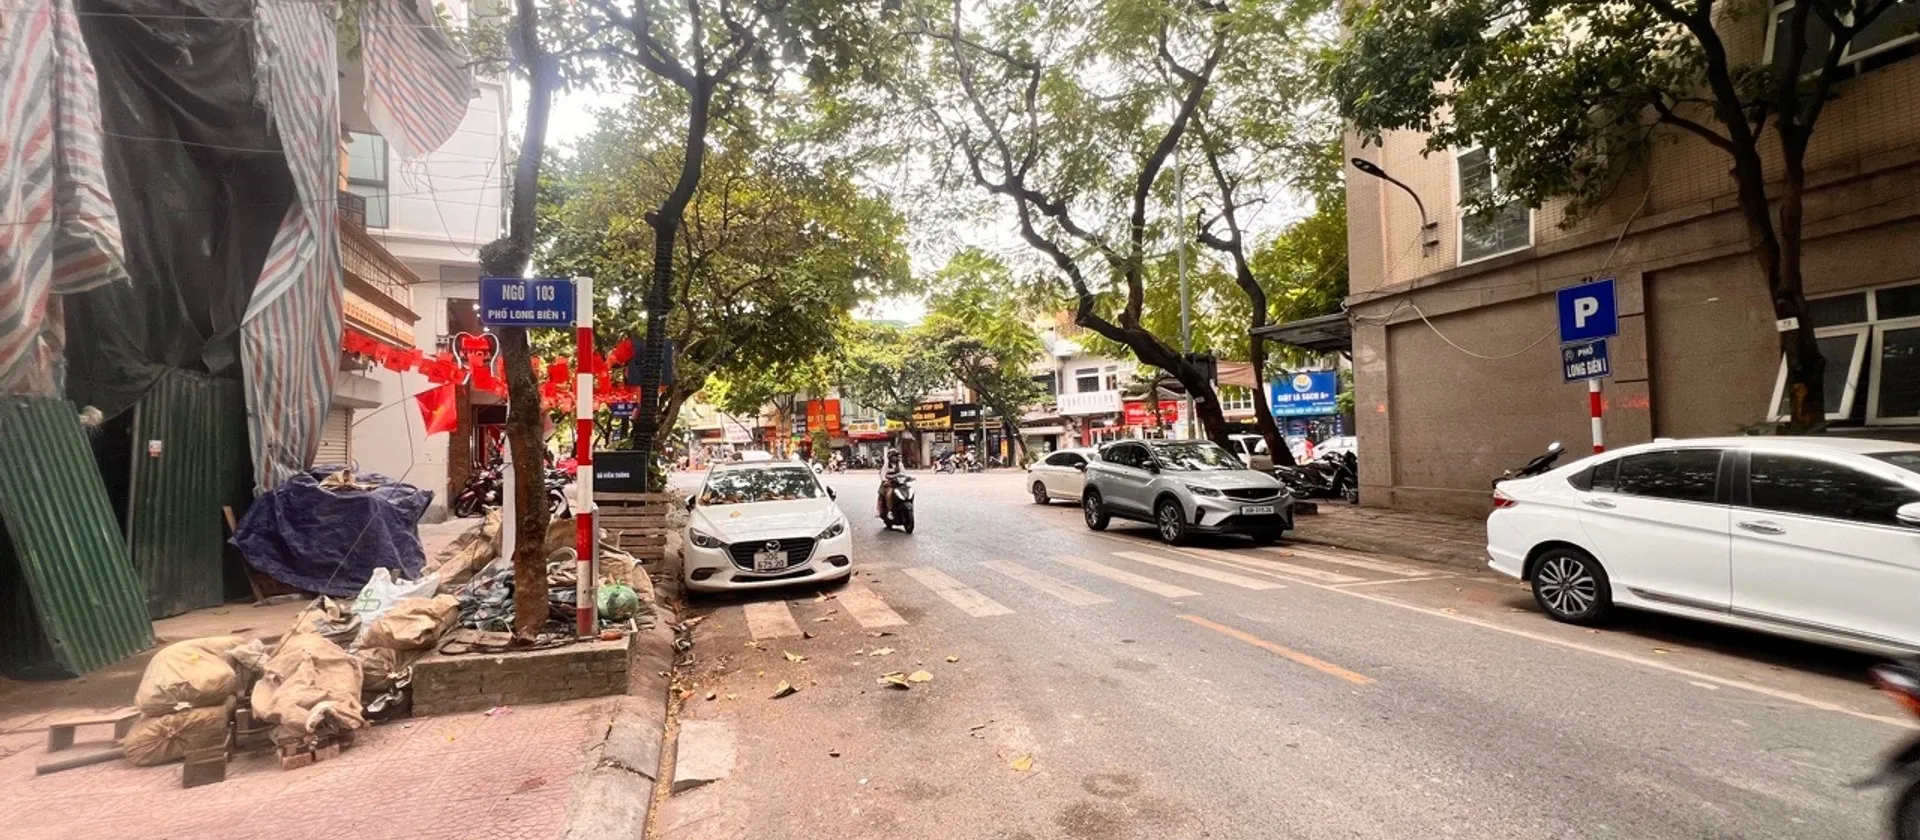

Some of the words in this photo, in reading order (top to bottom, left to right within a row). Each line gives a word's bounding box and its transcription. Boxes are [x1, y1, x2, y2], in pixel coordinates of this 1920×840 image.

[502, 282, 525, 301] NGÕ
[536, 285, 555, 301] 103
[488, 307, 508, 320] PHỐ
[510, 310, 535, 320] LONG
[537, 308, 559, 320] BIÊN
[561, 310, 566, 320] 1
[1574, 296, 1599, 329] P
[1578, 344, 1594, 357] PHỐ
[1566, 361, 1587, 378] LONG
